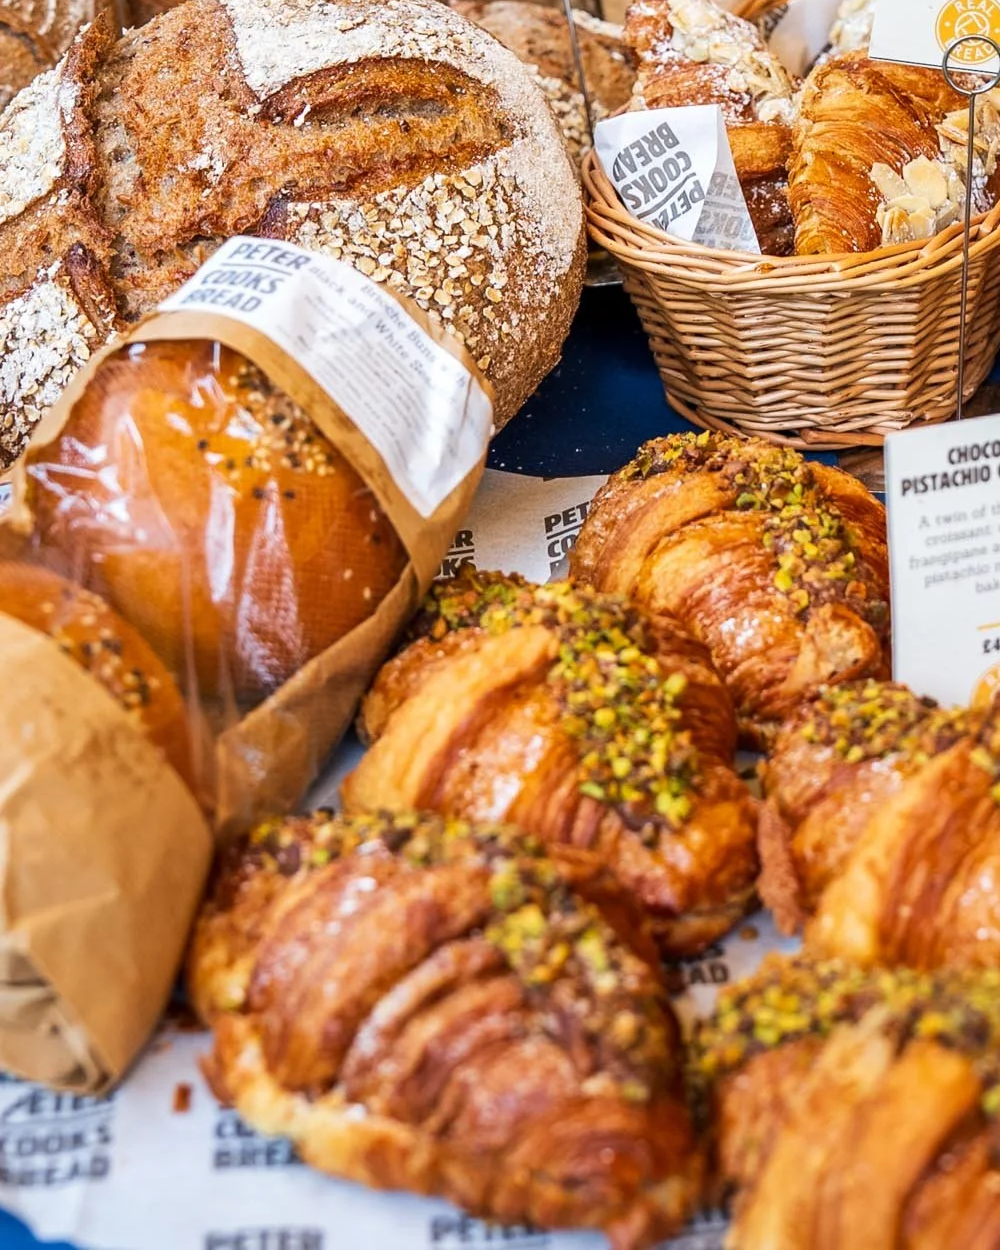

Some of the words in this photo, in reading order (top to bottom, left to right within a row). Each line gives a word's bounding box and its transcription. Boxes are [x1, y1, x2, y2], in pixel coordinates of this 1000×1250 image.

[621, 150, 692, 210] COOKS
[229, 242, 312, 272] PETER
[202, 269, 286, 295] COOKS
[902, 465, 991, 496] PISTACHIO
[544, 500, 593, 534] PET
